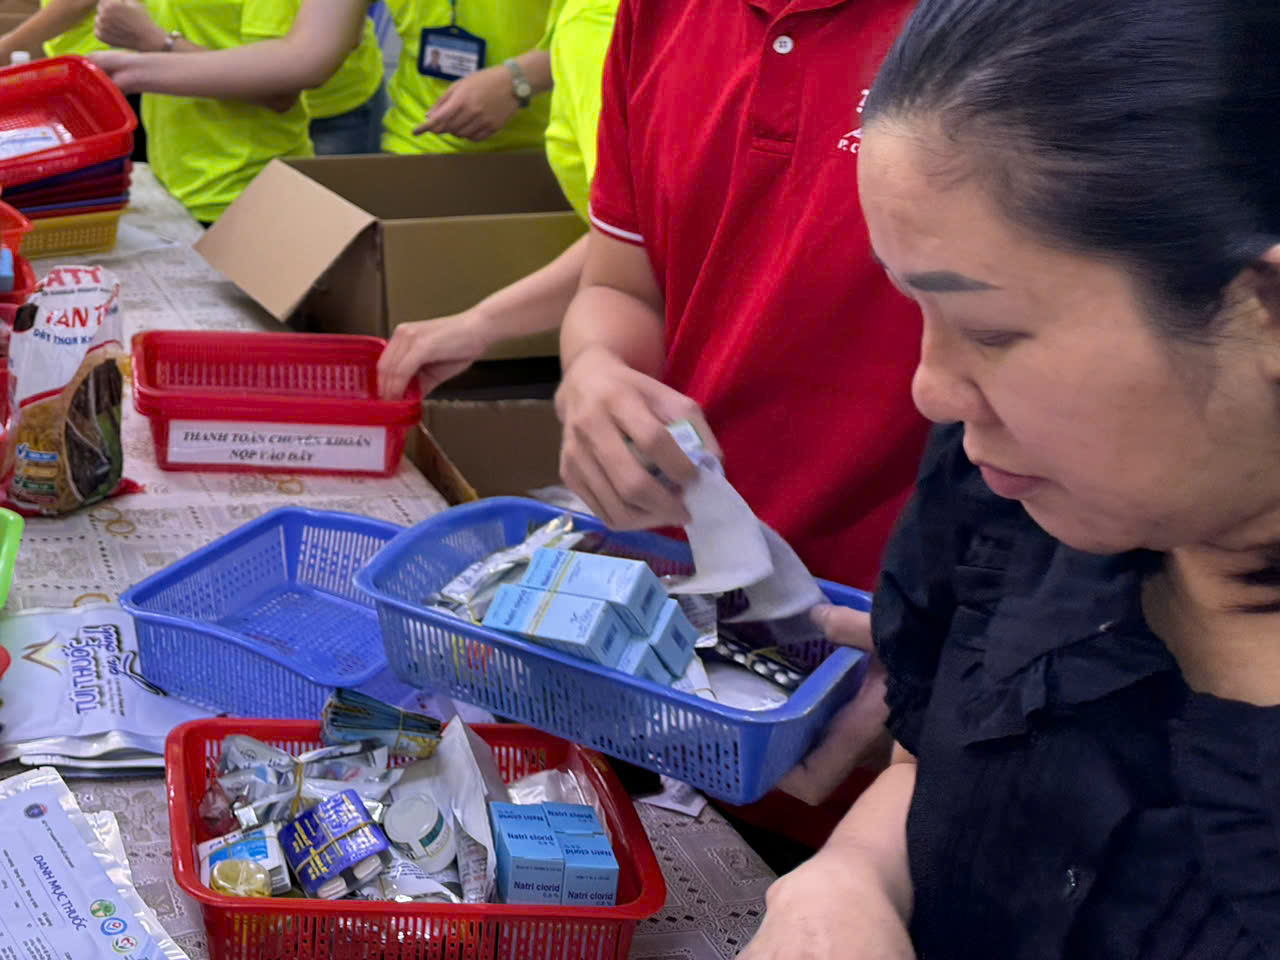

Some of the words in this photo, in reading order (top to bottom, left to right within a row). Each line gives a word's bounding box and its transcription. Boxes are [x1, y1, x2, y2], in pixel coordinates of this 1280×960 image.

[183, 431, 228, 441] THANH
[507, 832, 528, 840] Natri
[513, 881, 534, 890] Natri
[536, 882, 561, 892] clorid
[33, 854, 55, 880] DANH
[48, 880, 68, 902] MỤC
[61, 899, 88, 931] THUỐC
[567, 890, 589, 900] Natri
[589, 891, 614, 900] clorid
